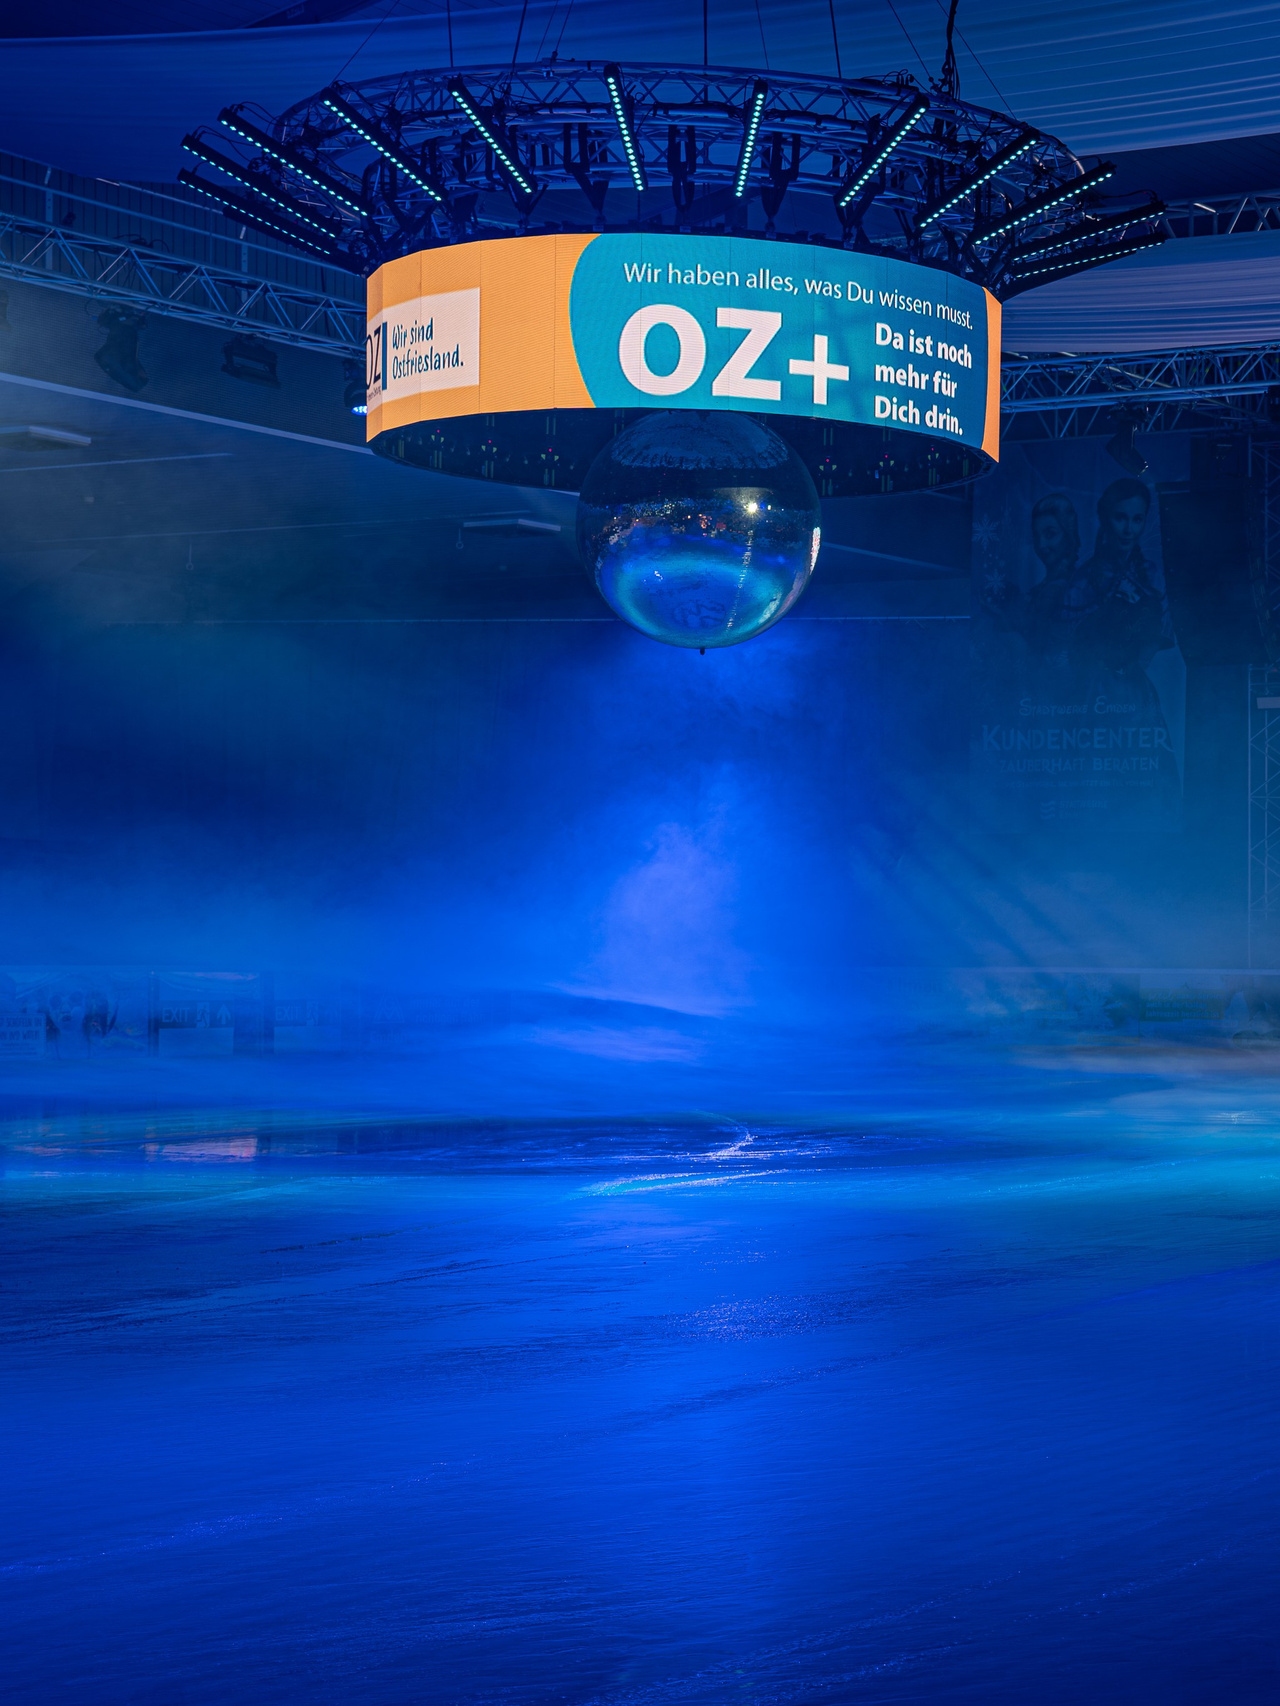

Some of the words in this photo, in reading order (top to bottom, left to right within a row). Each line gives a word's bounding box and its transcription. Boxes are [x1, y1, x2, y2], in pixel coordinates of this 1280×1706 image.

[624, 263, 660, 283] Wir
[668, 265, 740, 287] haben
[746, 268, 799, 295] alles,
[805, 278, 842, 300] was
[847, 281, 874, 305] Du
[879, 288, 932, 316] wissen
[937, 298, 973, 330] musst.
[392, 324, 408, 350] Wir
[410, 317, 433, 345] sind
[875, 322, 903, 350] Da
[909, 328, 933, 356] ist
[938, 336, 972, 369] noch
[392, 343, 464, 380] Ostfriesland.
[618, 303, 849, 405] OZ+
[875, 363, 930, 391] mehr
[933, 371, 957, 399] für
[875, 394, 920, 425] Dich
[925, 403, 963, 436] drin.
[982, 724, 1175, 753] KUNDENCENTER
[999, 759, 1085, 775] ZAUBERHAFT
[1092, 757, 1160, 774] BERATEN
[162, 1007, 190, 1022] EXIT
[275, 1006, 301, 1021] EXIT
